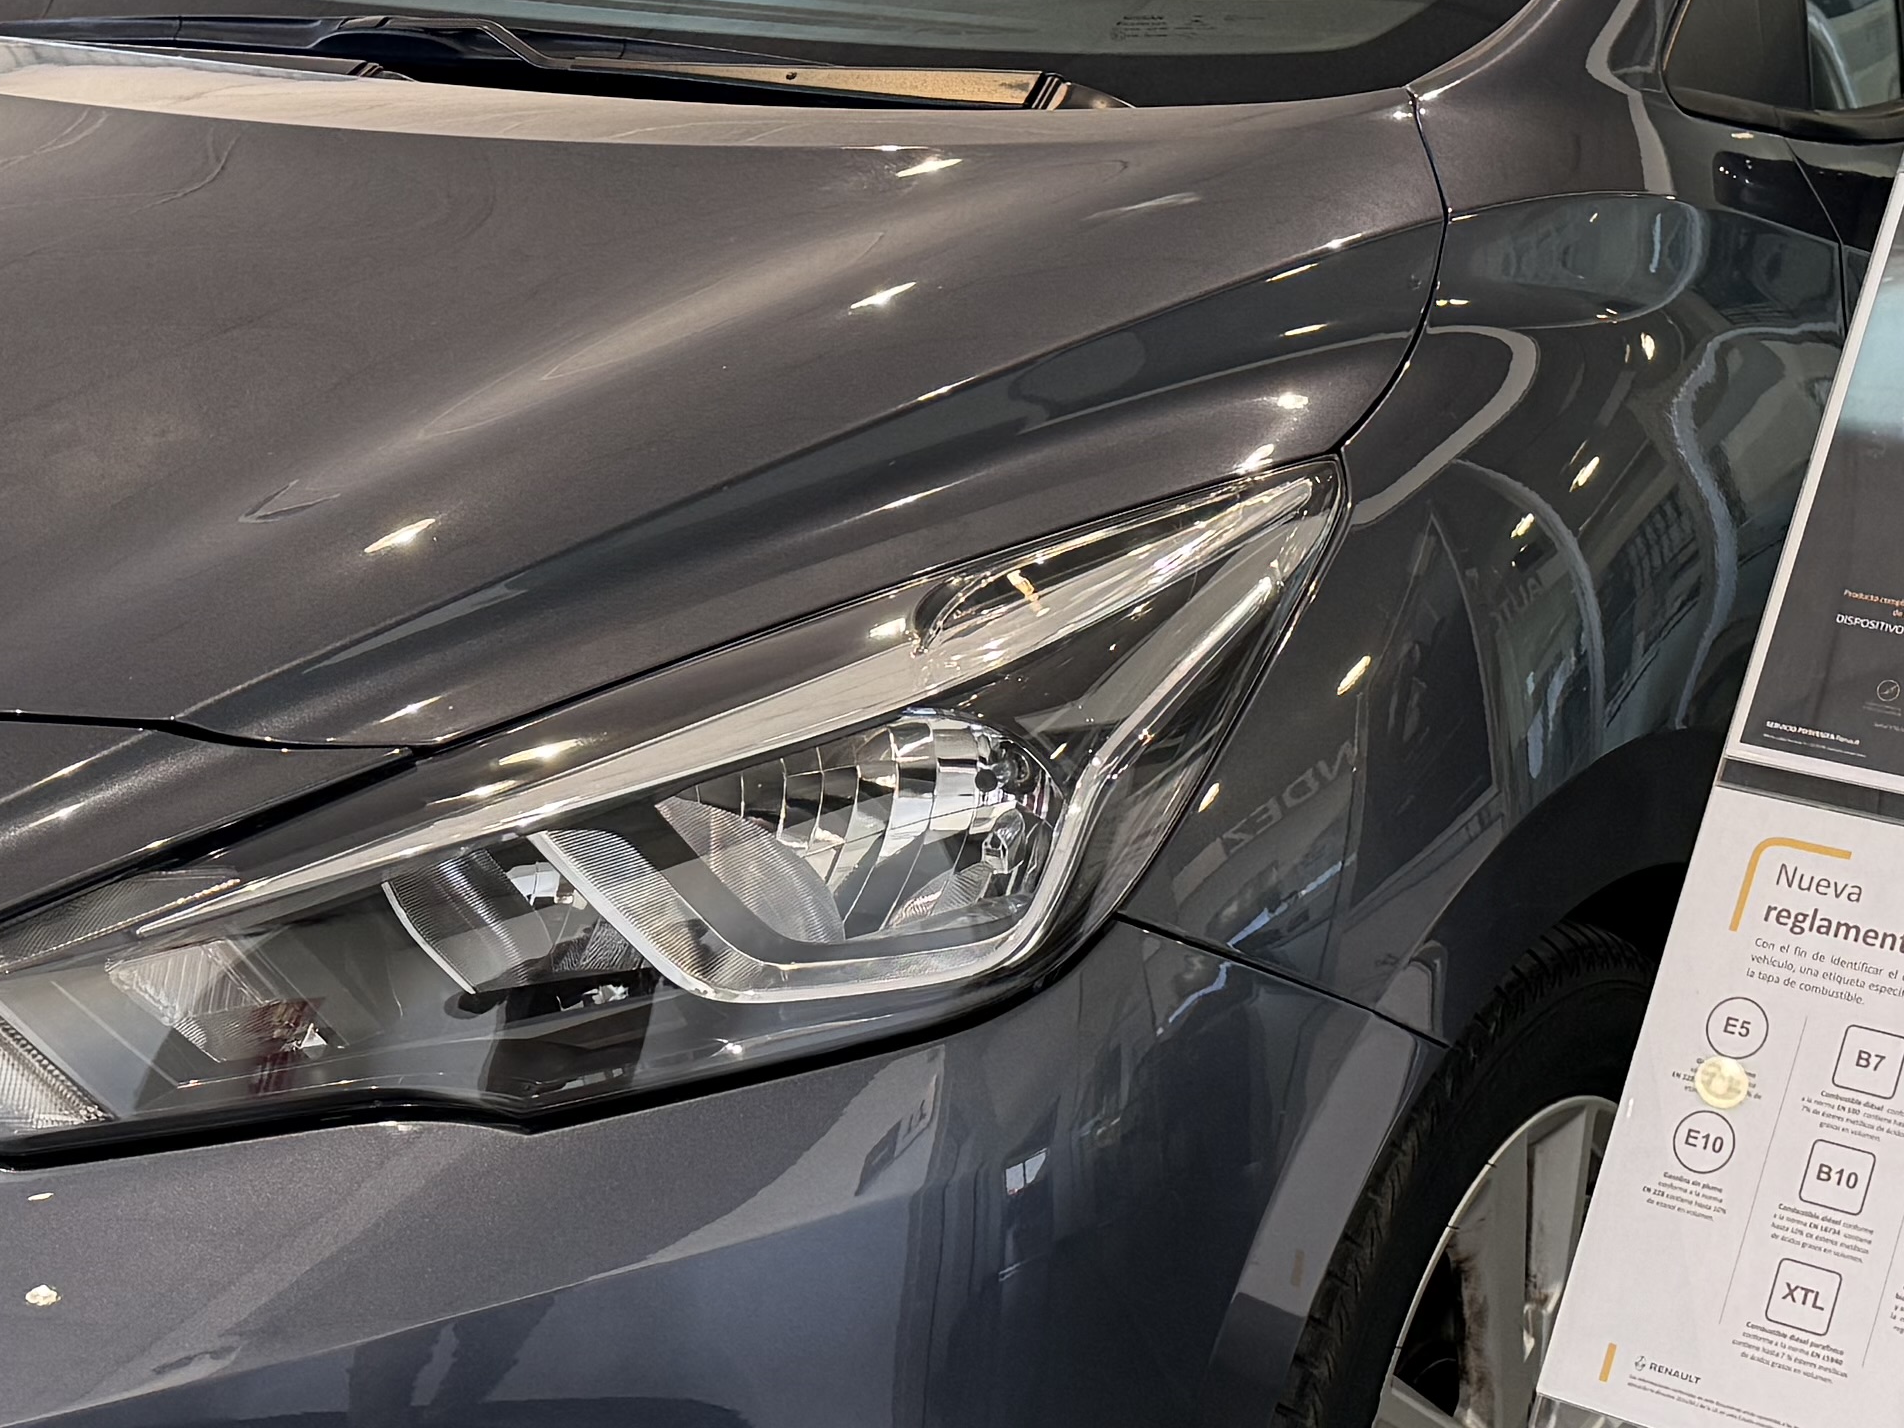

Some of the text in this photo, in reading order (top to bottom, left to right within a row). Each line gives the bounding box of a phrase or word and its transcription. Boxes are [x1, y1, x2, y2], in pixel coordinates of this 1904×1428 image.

[1835, 613, 1904, 635] DISPOSITIVO
[1775, 863, 1863, 903] Nueva
[1750, 954, 1796, 974] vehículo,
[1799, 965, 1820, 978] una
[1821, 971, 1866, 989] etiqueta
[1754, 937, 1776, 951] Con
[1779, 943, 1791, 954] el
[1793, 945, 1808, 958] fin
[1811, 951, 1826, 963] de
[1830, 955, 1884, 976] identificar
[1887, 969, 1899, 980] el
[1746, 967, 1865, 1005] la tapa de combustible.
[1722, 1016, 1752, 1038] E5
[1855, 1049, 1887, 1072] B7
[1684, 1128, 1724, 1154] E10
[1816, 1162, 1859, 1190] B10
[1781, 1281, 1825, 1312] XTL
[1649, 1362, 1702, 1384] RENAULT
